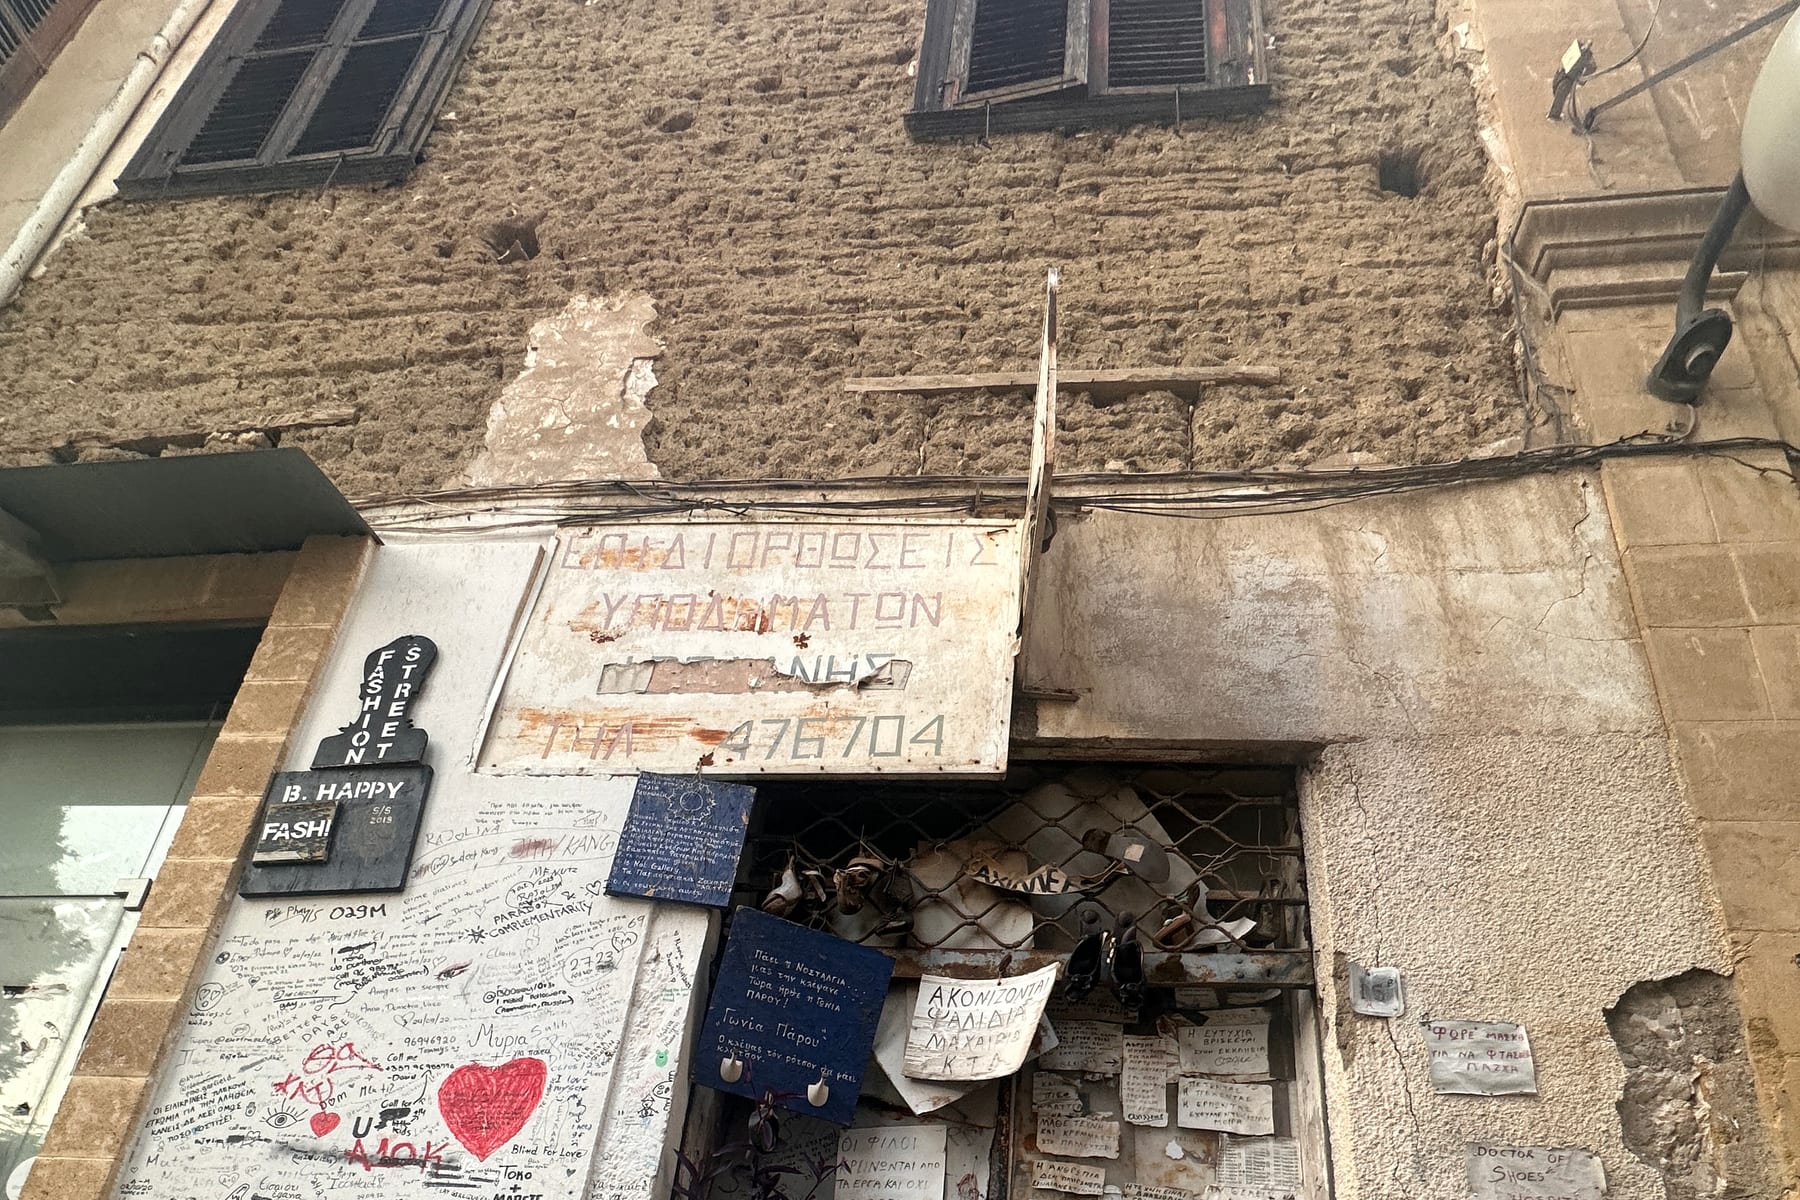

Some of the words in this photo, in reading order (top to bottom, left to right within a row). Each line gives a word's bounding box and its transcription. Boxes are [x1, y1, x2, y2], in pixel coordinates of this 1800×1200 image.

[602, 592, 942, 632] ΥΠΟΔΗΜΑΤΩΝ
[345, 650, 395, 763] FASHION
[376, 646, 422, 758] STREET
[718, 714, 945, 761] 476704
[316, 781, 404, 801] HAPPY
[262, 819, 332, 841] FASH!
[489, 901, 593, 937] COMPLEMENTARITY
[511, 1144, 538, 1155] Blind
